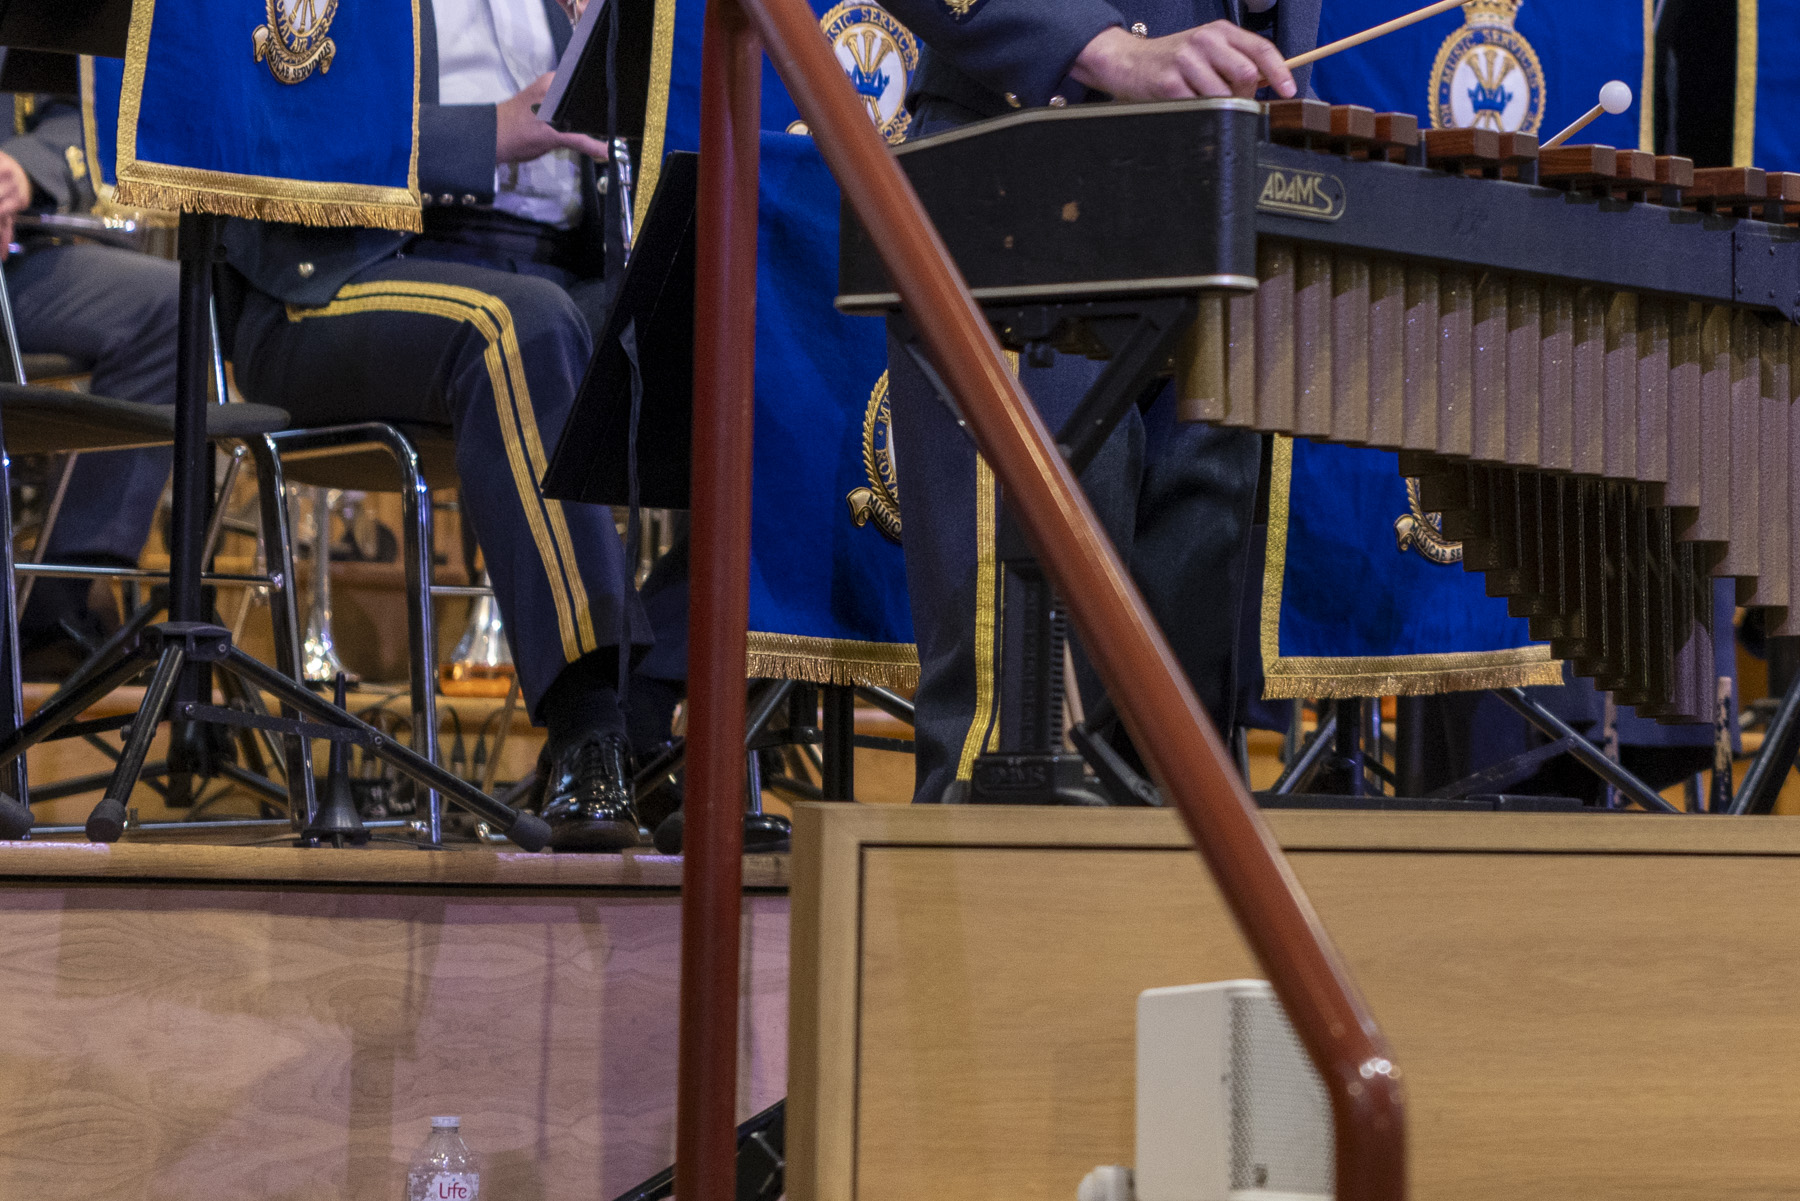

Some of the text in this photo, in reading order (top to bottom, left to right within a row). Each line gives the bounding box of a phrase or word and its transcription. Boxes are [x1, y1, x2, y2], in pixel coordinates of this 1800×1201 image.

[289, 36, 309, 54] AIR
[826, 7, 916, 71] SIC SERVICES
[1258, 171, 1334, 215] ADAMS
[1410, 520, 1447, 560] MUSICAE
[439, 1180, 468, 1199] Life
